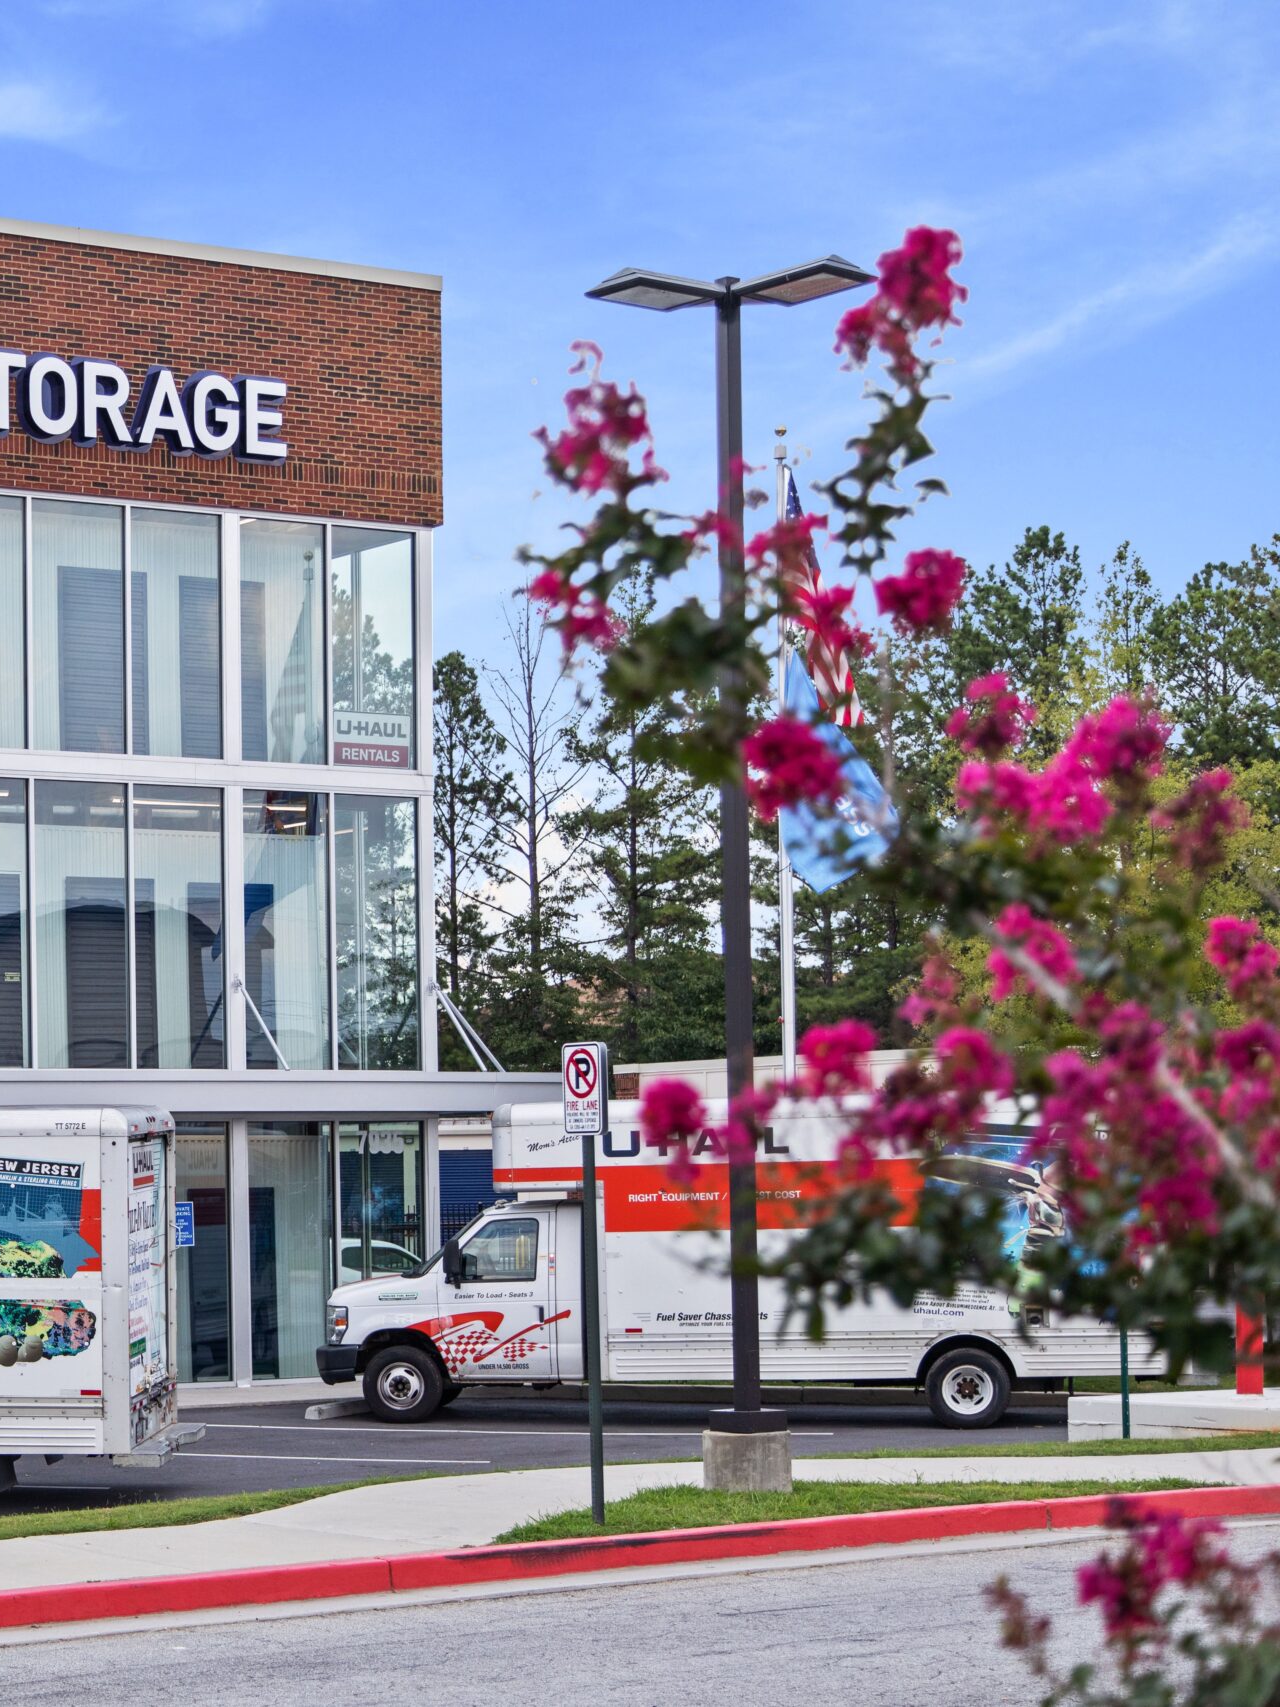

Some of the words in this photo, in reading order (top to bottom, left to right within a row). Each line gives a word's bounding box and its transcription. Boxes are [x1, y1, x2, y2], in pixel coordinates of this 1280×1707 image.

[336, 719, 407, 739] U-HAUL
[342, 747, 400, 763] RENTALS
[566, 1101, 579, 1111] FIRE
[582, 1100, 598, 1111] LANE
[81, 1122, 86, 1130] E
[527, 1140, 556, 1153] Mom's
[558, 1134, 581, 1146] Attic
[22, 1162, 79, 1177] JERSEY
[628, 1193, 658, 1203] RIGHT
[662, 1192, 720, 1203] EQUIPMENT
[774, 1190, 802, 1200] COST
[656, 1312, 675, 1321] Fuel
[913, 1307, 965, 1317] uhaul.com
